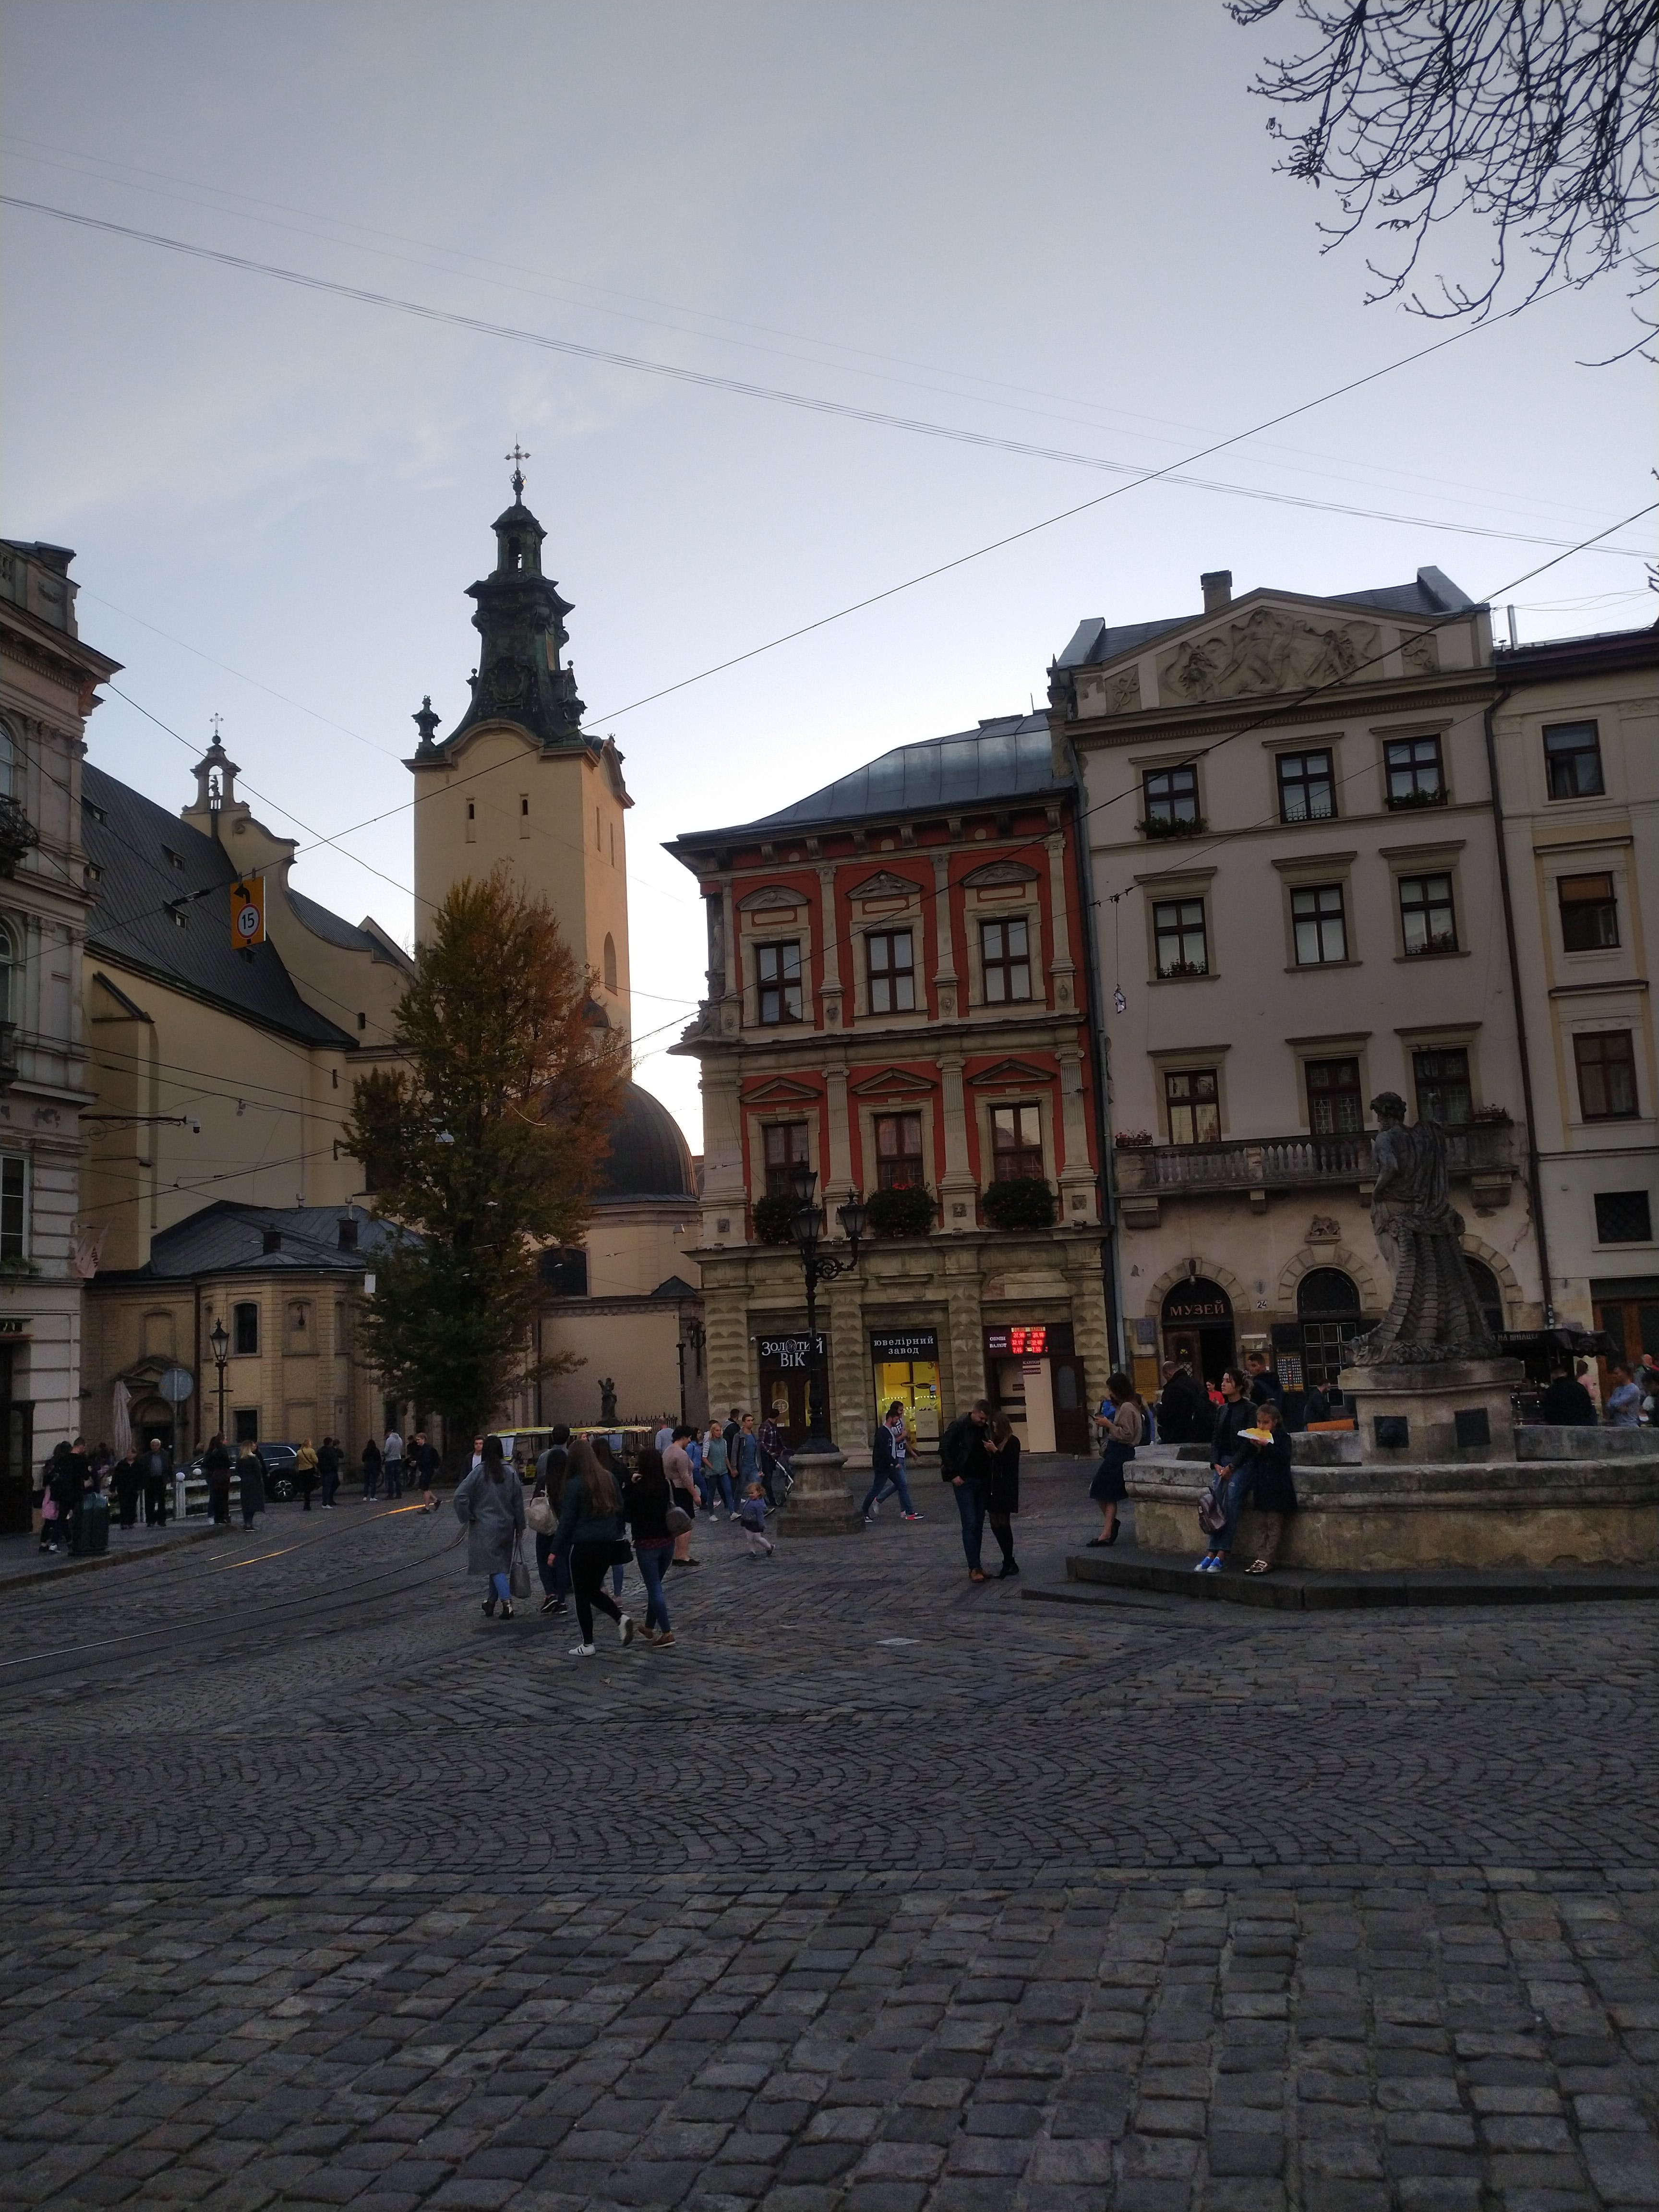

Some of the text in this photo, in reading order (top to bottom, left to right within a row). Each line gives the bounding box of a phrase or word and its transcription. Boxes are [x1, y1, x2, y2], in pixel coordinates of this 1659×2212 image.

[241, 913, 254, 929] 15
[1170, 1299, 1225, 1316] МУЗЕЙ
[874, 1335, 934, 1346] ювелірний
[781, 1352, 805, 1367] ВІК
